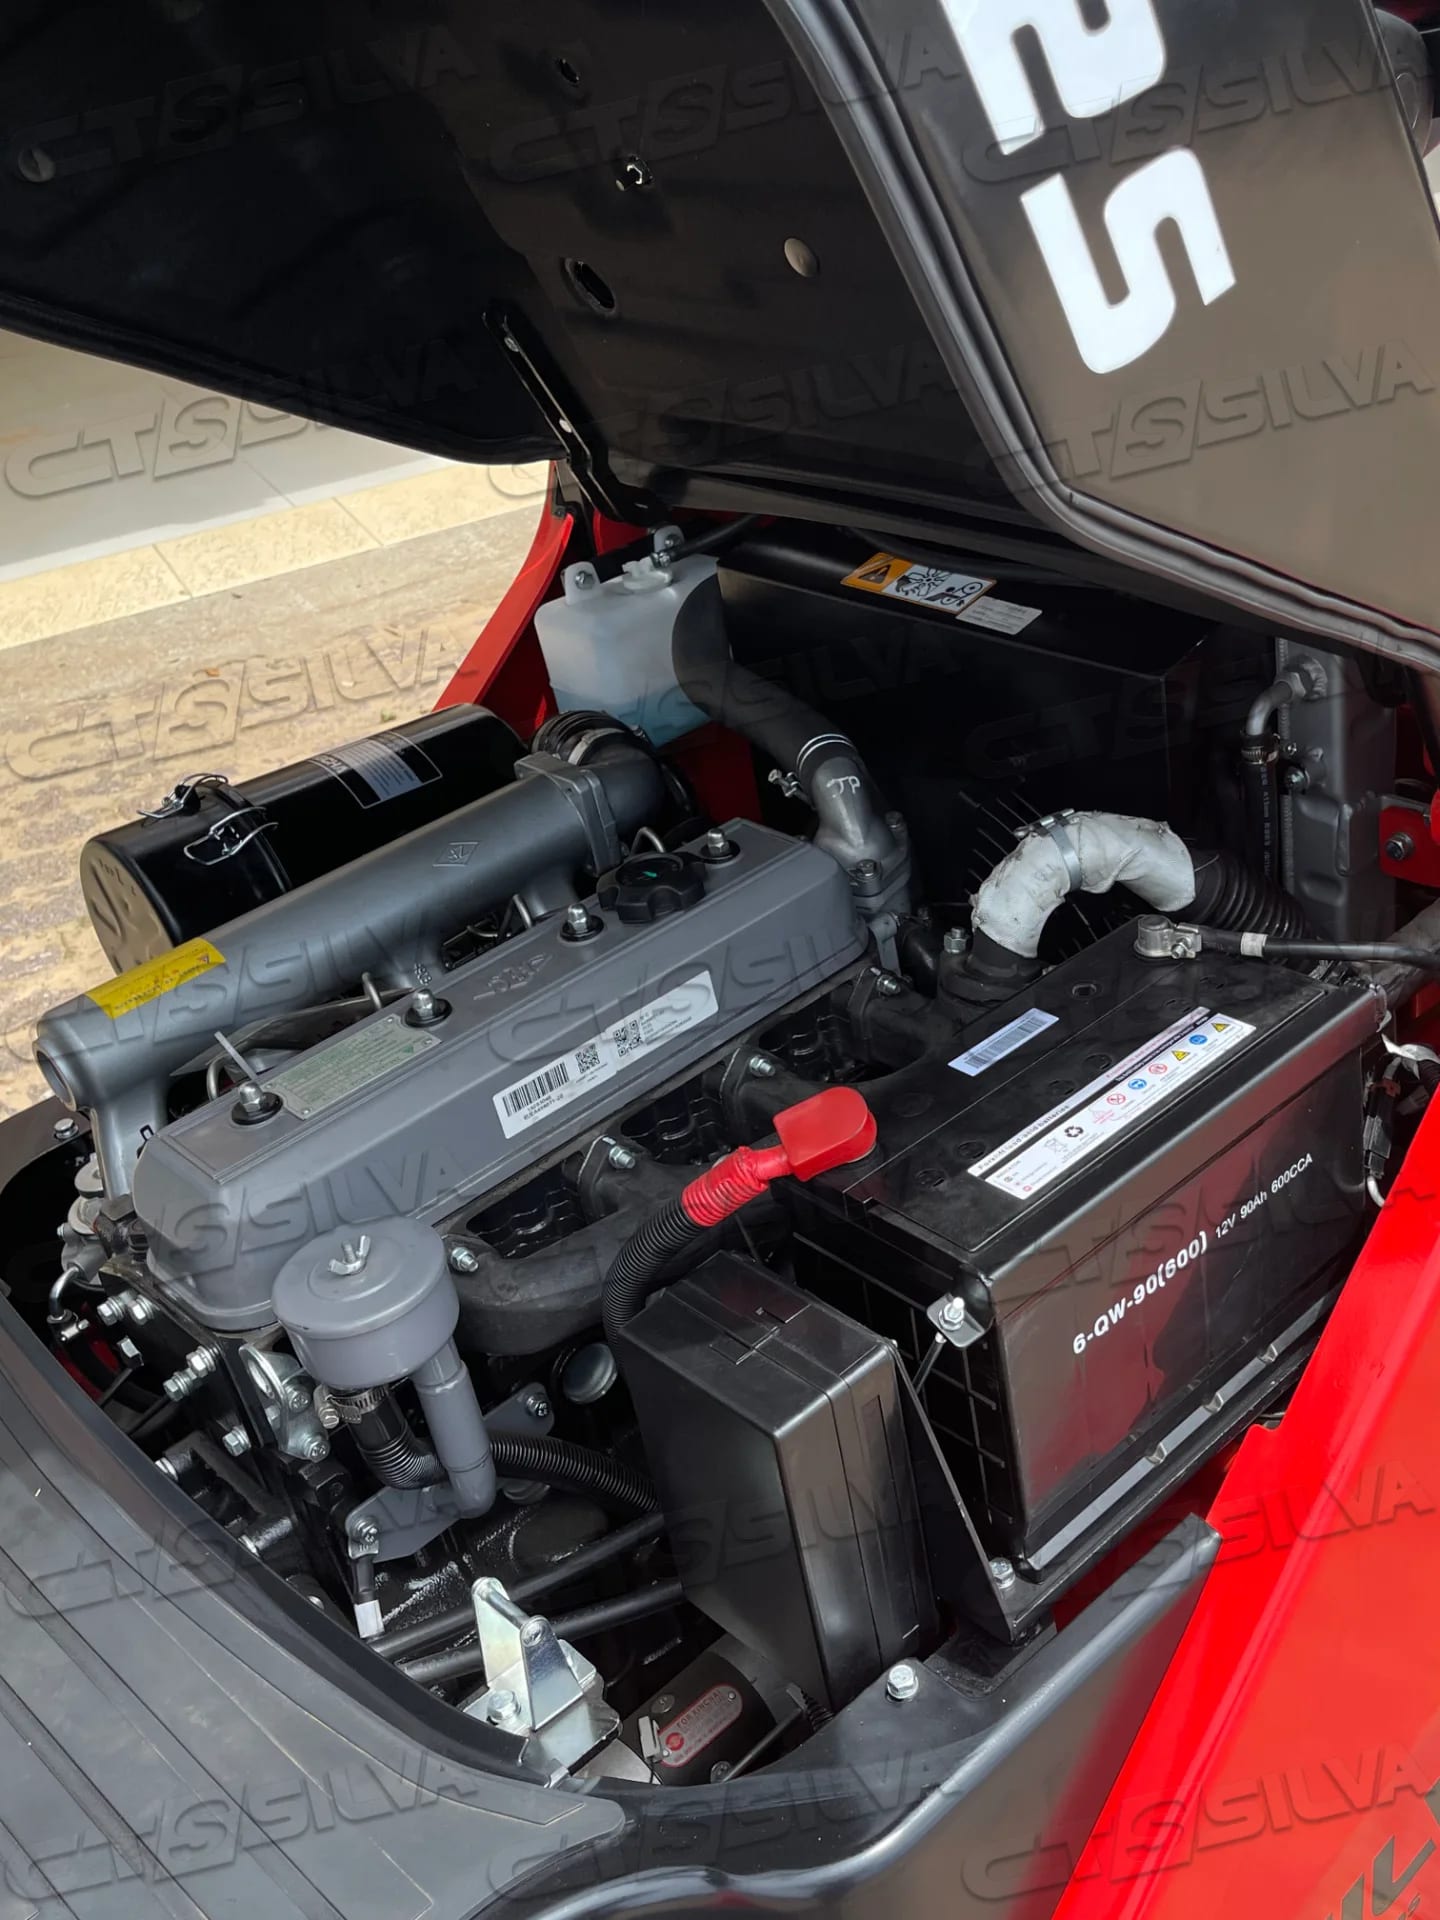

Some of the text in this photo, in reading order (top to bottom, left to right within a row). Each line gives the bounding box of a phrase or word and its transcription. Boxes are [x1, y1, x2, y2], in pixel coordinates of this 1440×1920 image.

[1073, 1153, 1313, 1354] 6-QW-90(600) 12V 90Ah 600CCA
